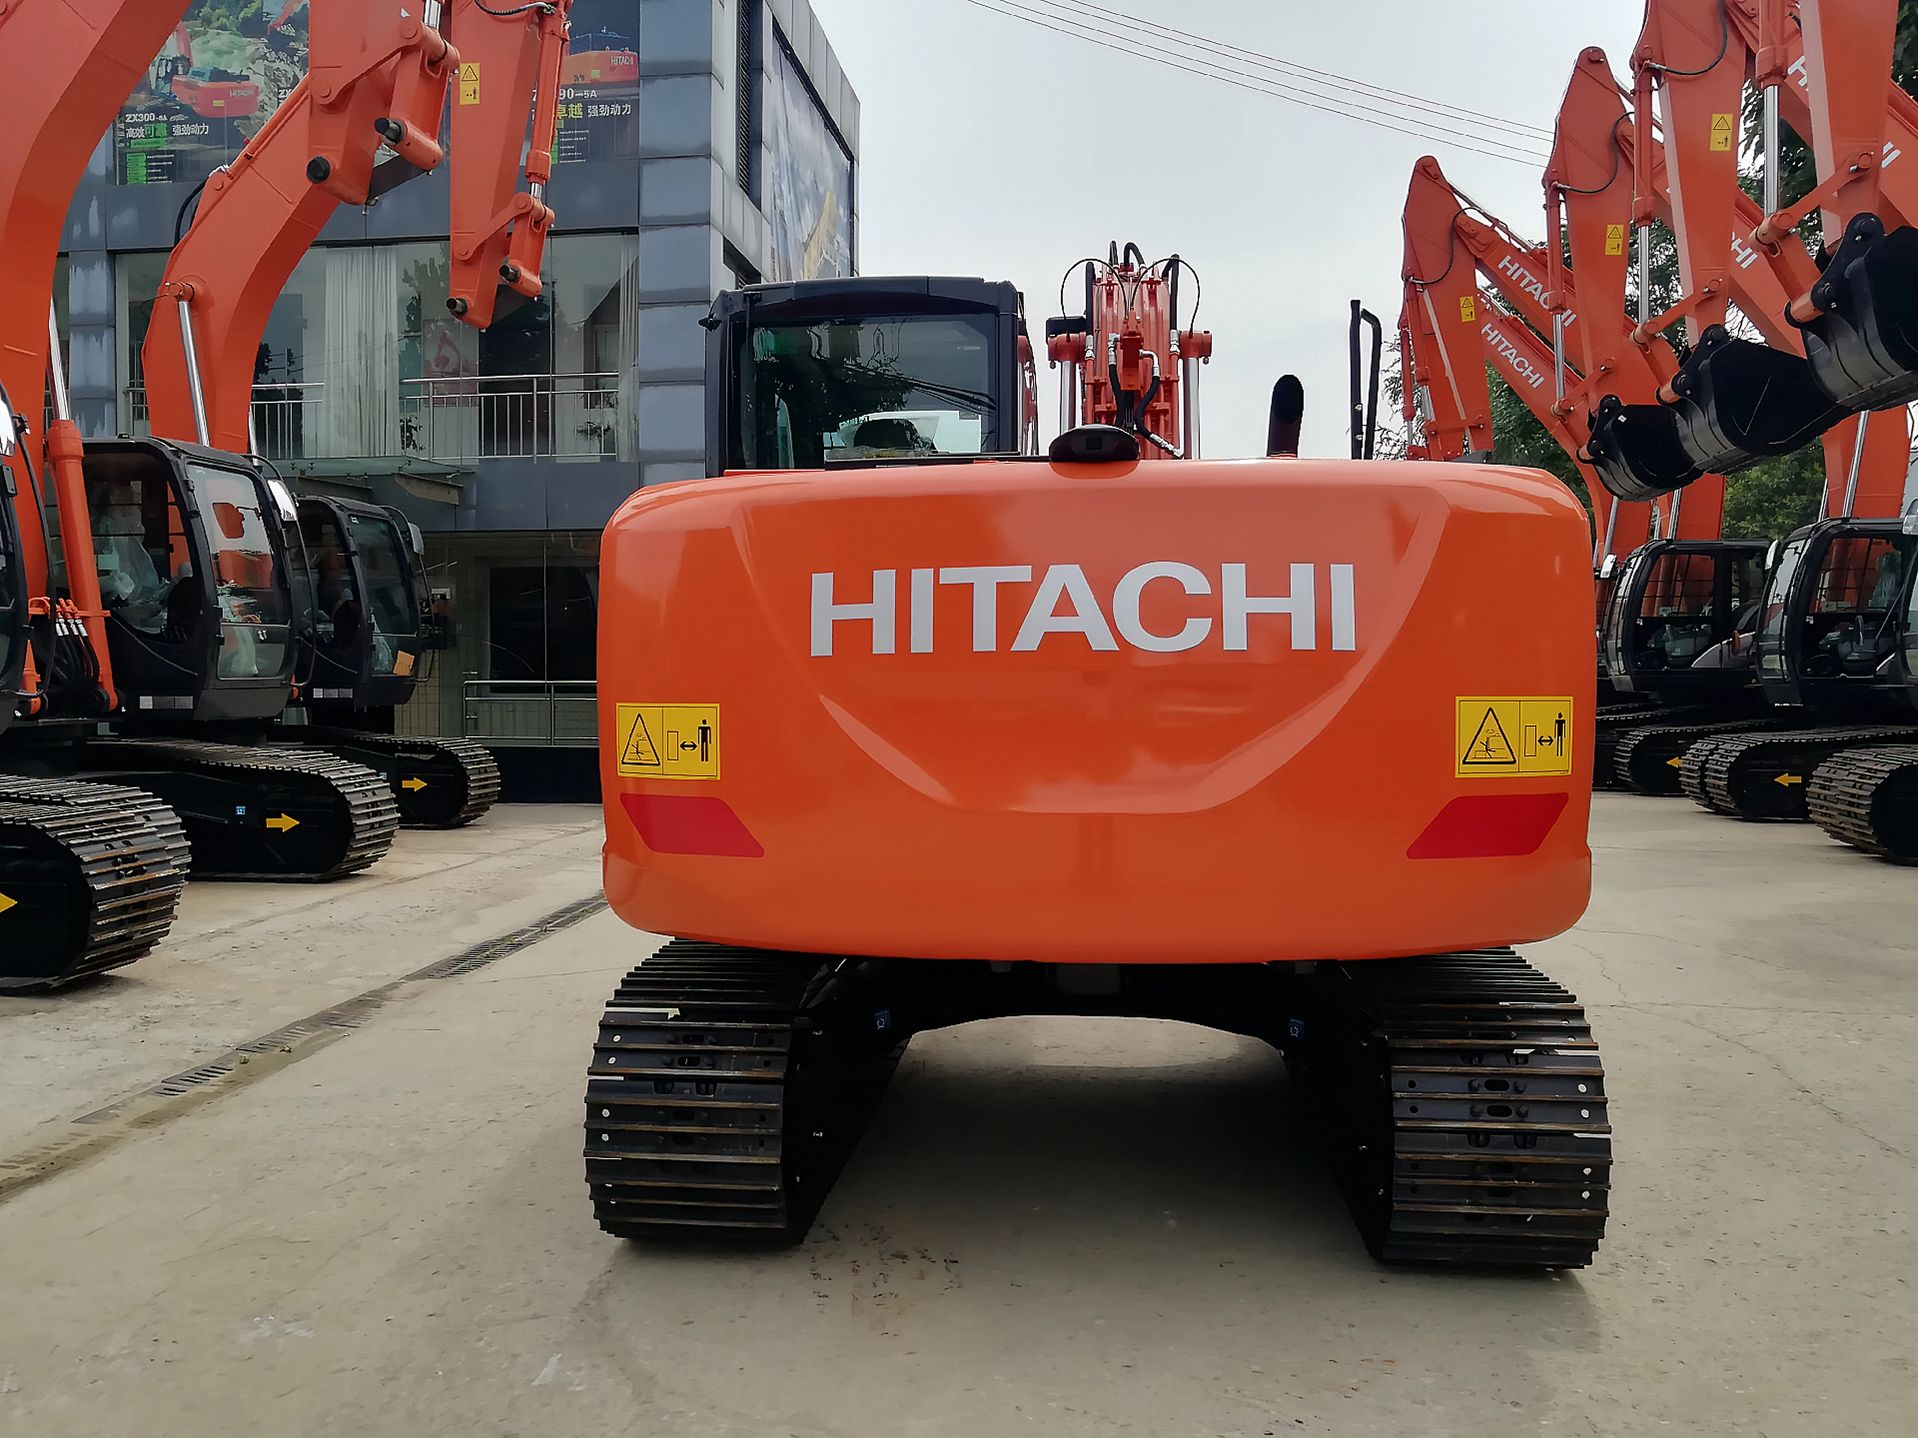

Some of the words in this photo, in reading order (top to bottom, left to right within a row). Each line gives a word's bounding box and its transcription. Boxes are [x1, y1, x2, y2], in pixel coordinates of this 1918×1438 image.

[172, 123, 209, 136] 强劲动力
[588, 103, 631, 118] 强劲动力
[1481, 323, 1545, 389] HITACHI
[810, 561, 1356, 657] HITACHI
